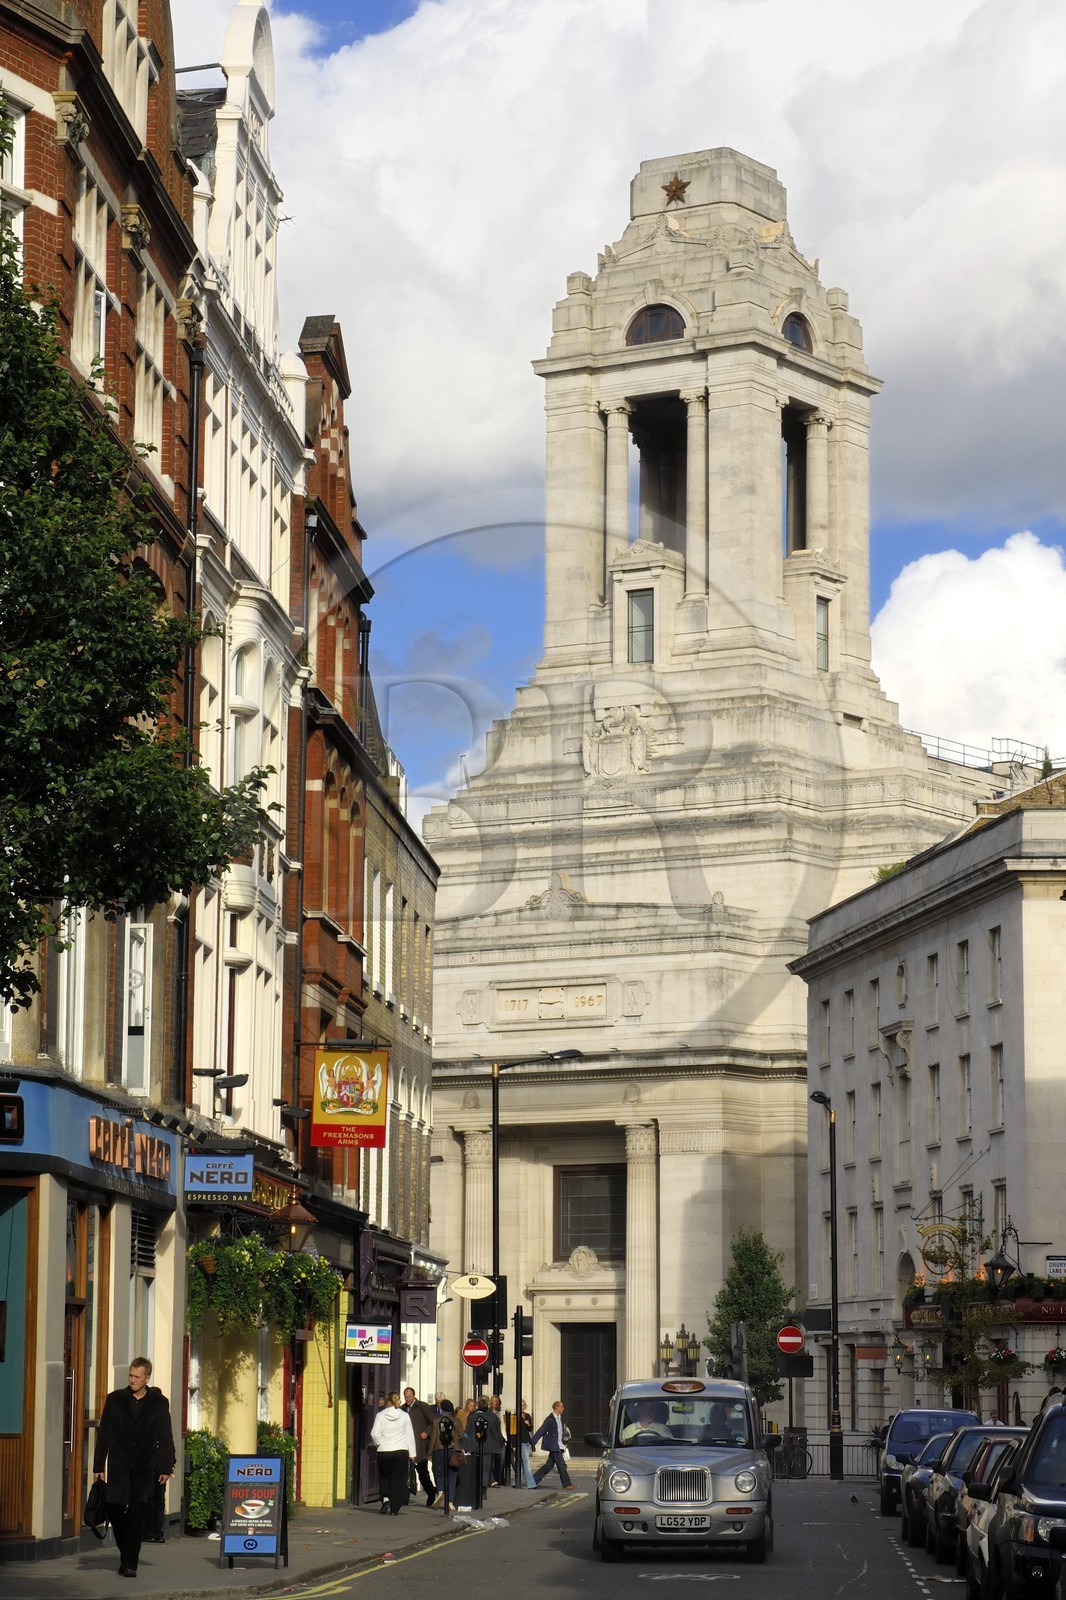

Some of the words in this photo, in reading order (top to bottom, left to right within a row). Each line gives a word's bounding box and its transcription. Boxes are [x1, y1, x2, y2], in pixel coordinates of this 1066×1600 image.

[504, 999, 529, 1011] 1717
[575, 995, 603, 1008] 1967
[323, 1132, 374, 1140] FREEMASONS
[190, 1170, 248, 1184] NERO
[232, 1489, 250, 1498] HOT
[252, 1489, 275, 1499] SOUP
[660, 1517, 685, 1526] LG52
[688, 1517, 706, 1526] YDP
